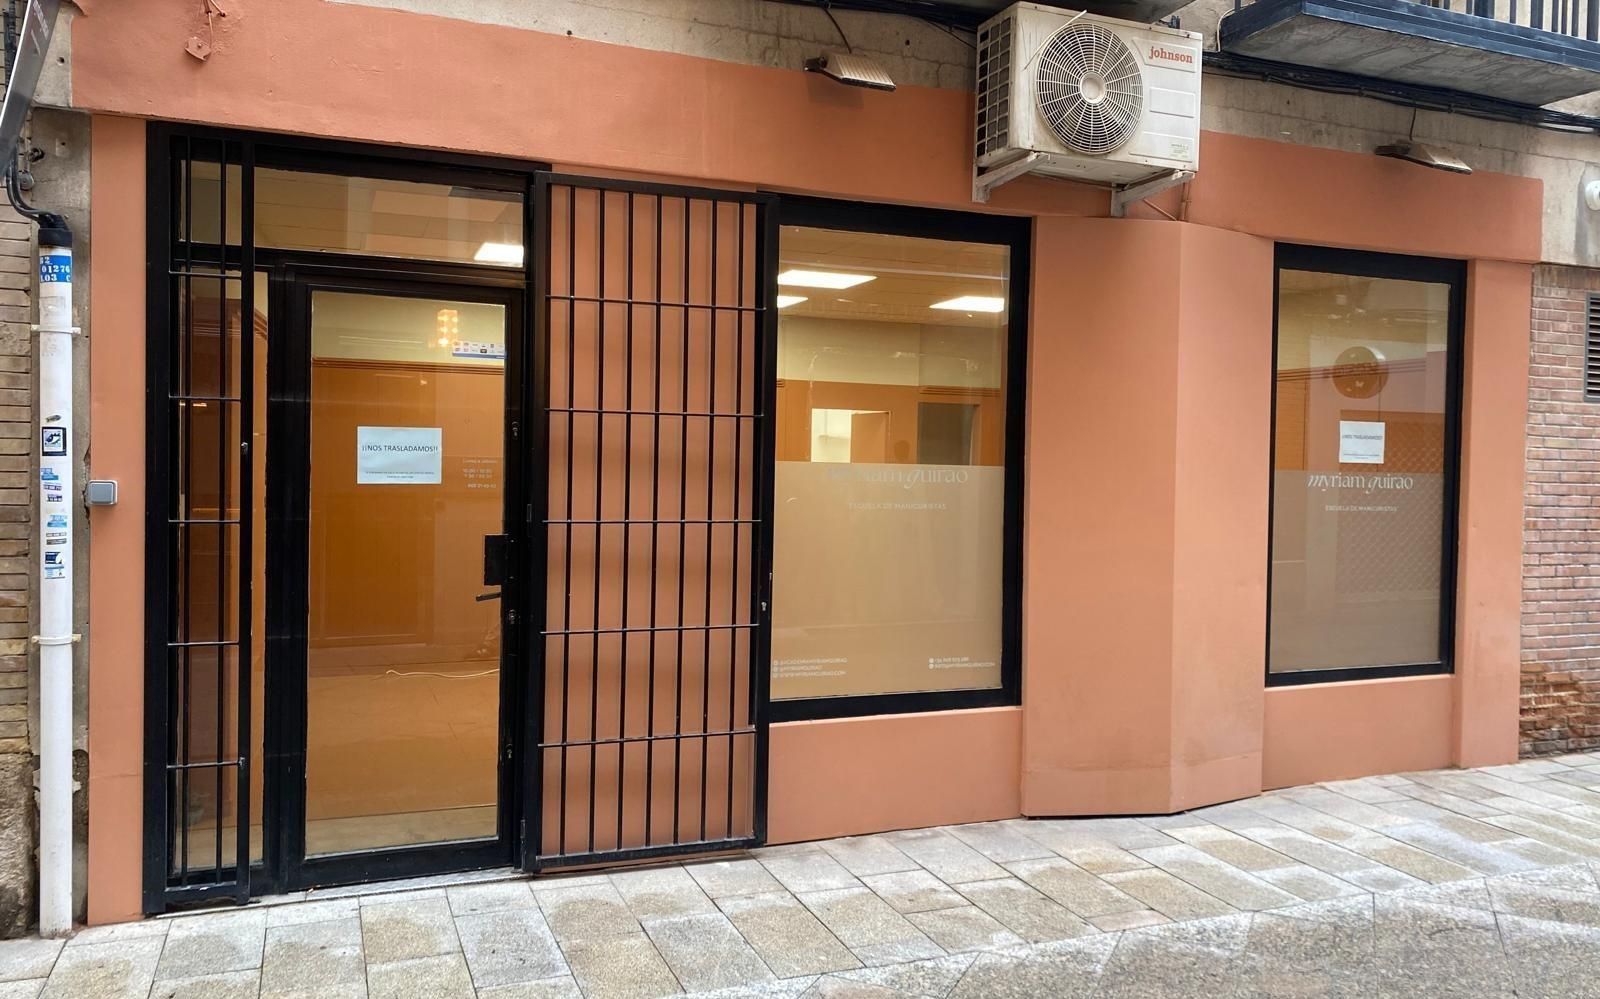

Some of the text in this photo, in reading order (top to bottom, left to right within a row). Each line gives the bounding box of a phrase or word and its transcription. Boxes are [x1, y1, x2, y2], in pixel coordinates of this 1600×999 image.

[1149, 46, 1193, 63] johnson
[1308, 472, 1413, 494] myriam guirao
